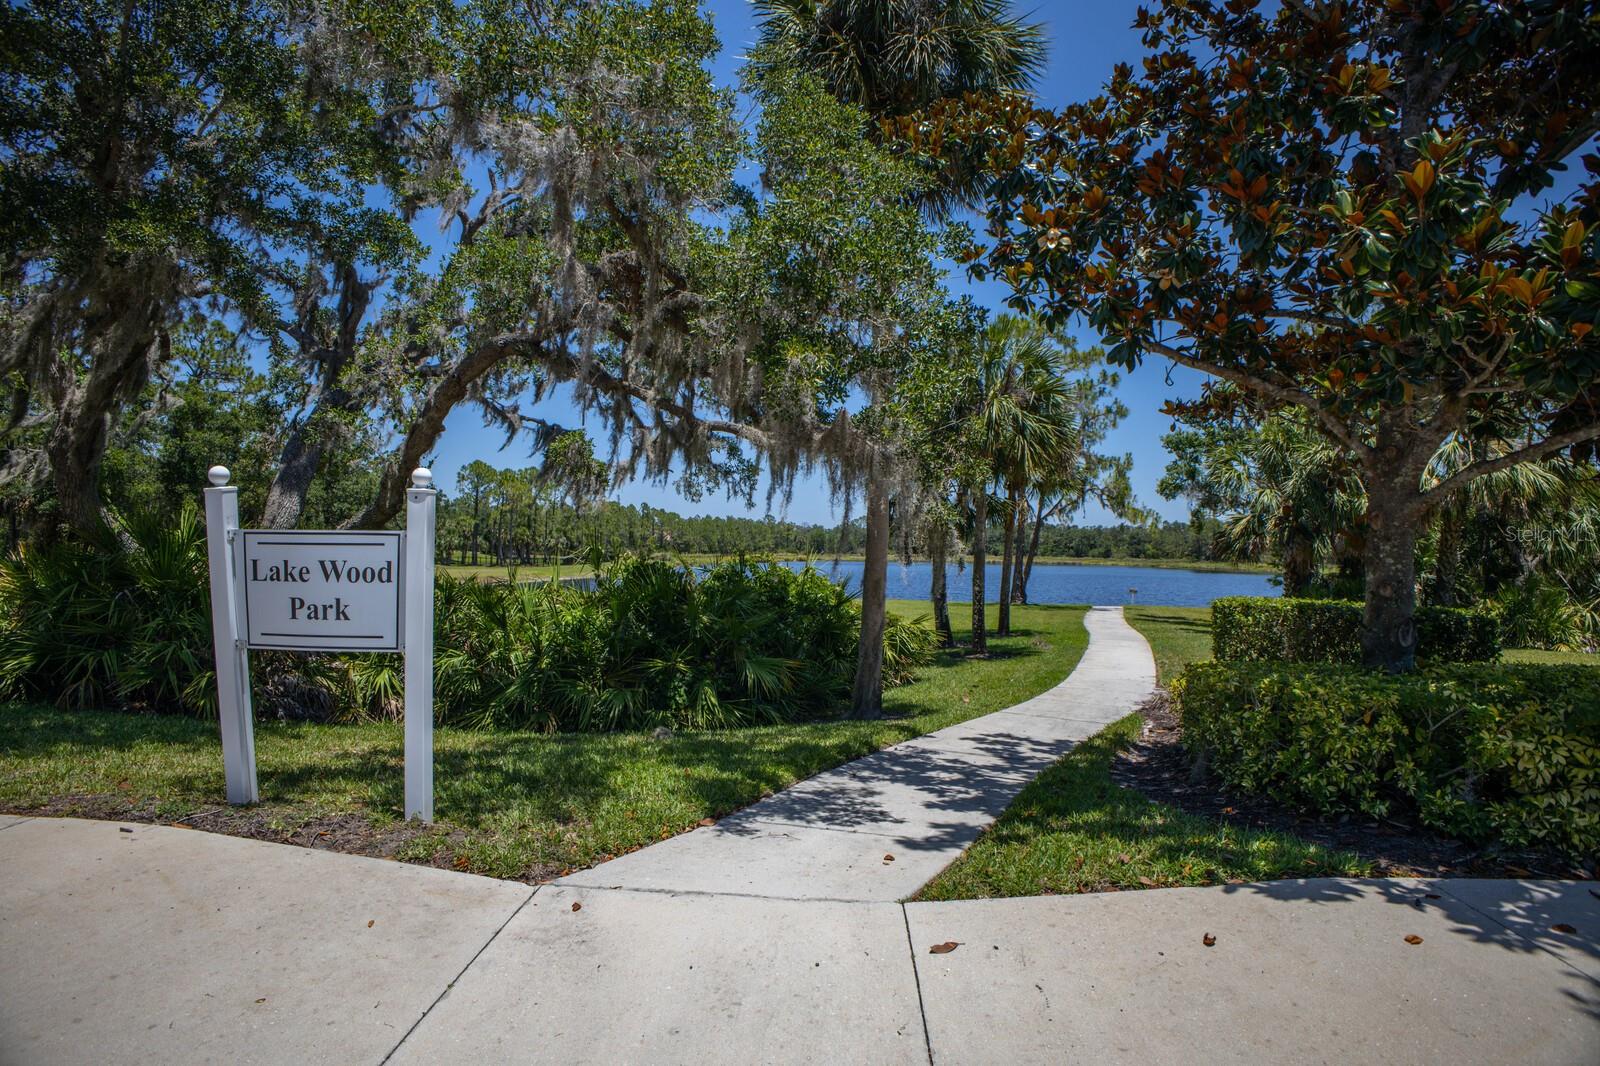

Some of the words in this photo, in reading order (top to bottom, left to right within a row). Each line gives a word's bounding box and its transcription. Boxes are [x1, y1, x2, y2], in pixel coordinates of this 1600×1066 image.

[249, 558, 311, 583] Lake
[318, 559, 393, 584] Wood
[288, 596, 351, 621] Park
